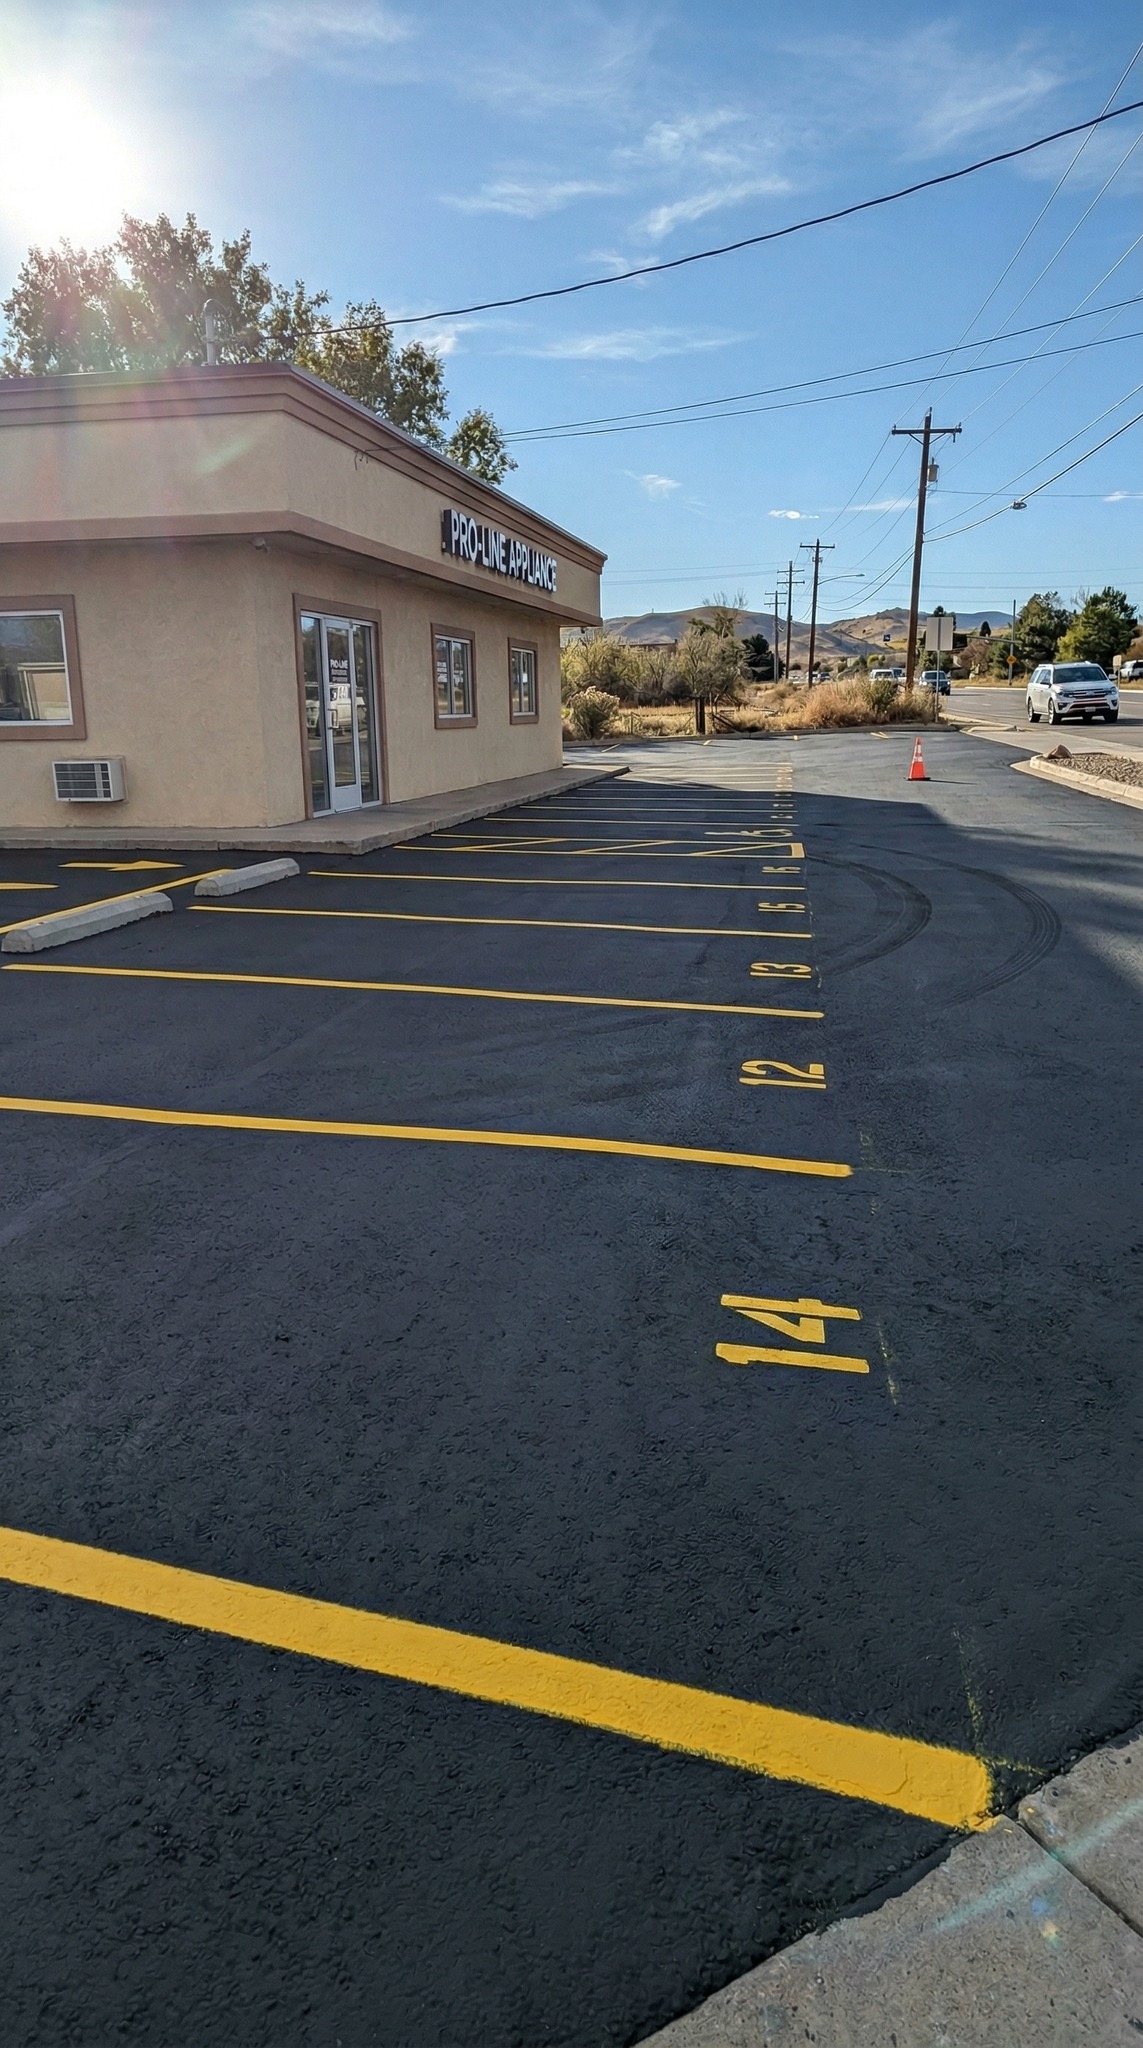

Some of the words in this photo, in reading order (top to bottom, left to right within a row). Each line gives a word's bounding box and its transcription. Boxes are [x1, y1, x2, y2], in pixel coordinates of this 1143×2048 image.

[450, 509, 507, 573] PRO-LINE
[509, 538, 557, 592] APPLIANCE
[750, 962, 812, 979] 13
[739, 1059, 827, 1090] 12
[715, 1293, 870, 1374] 14
